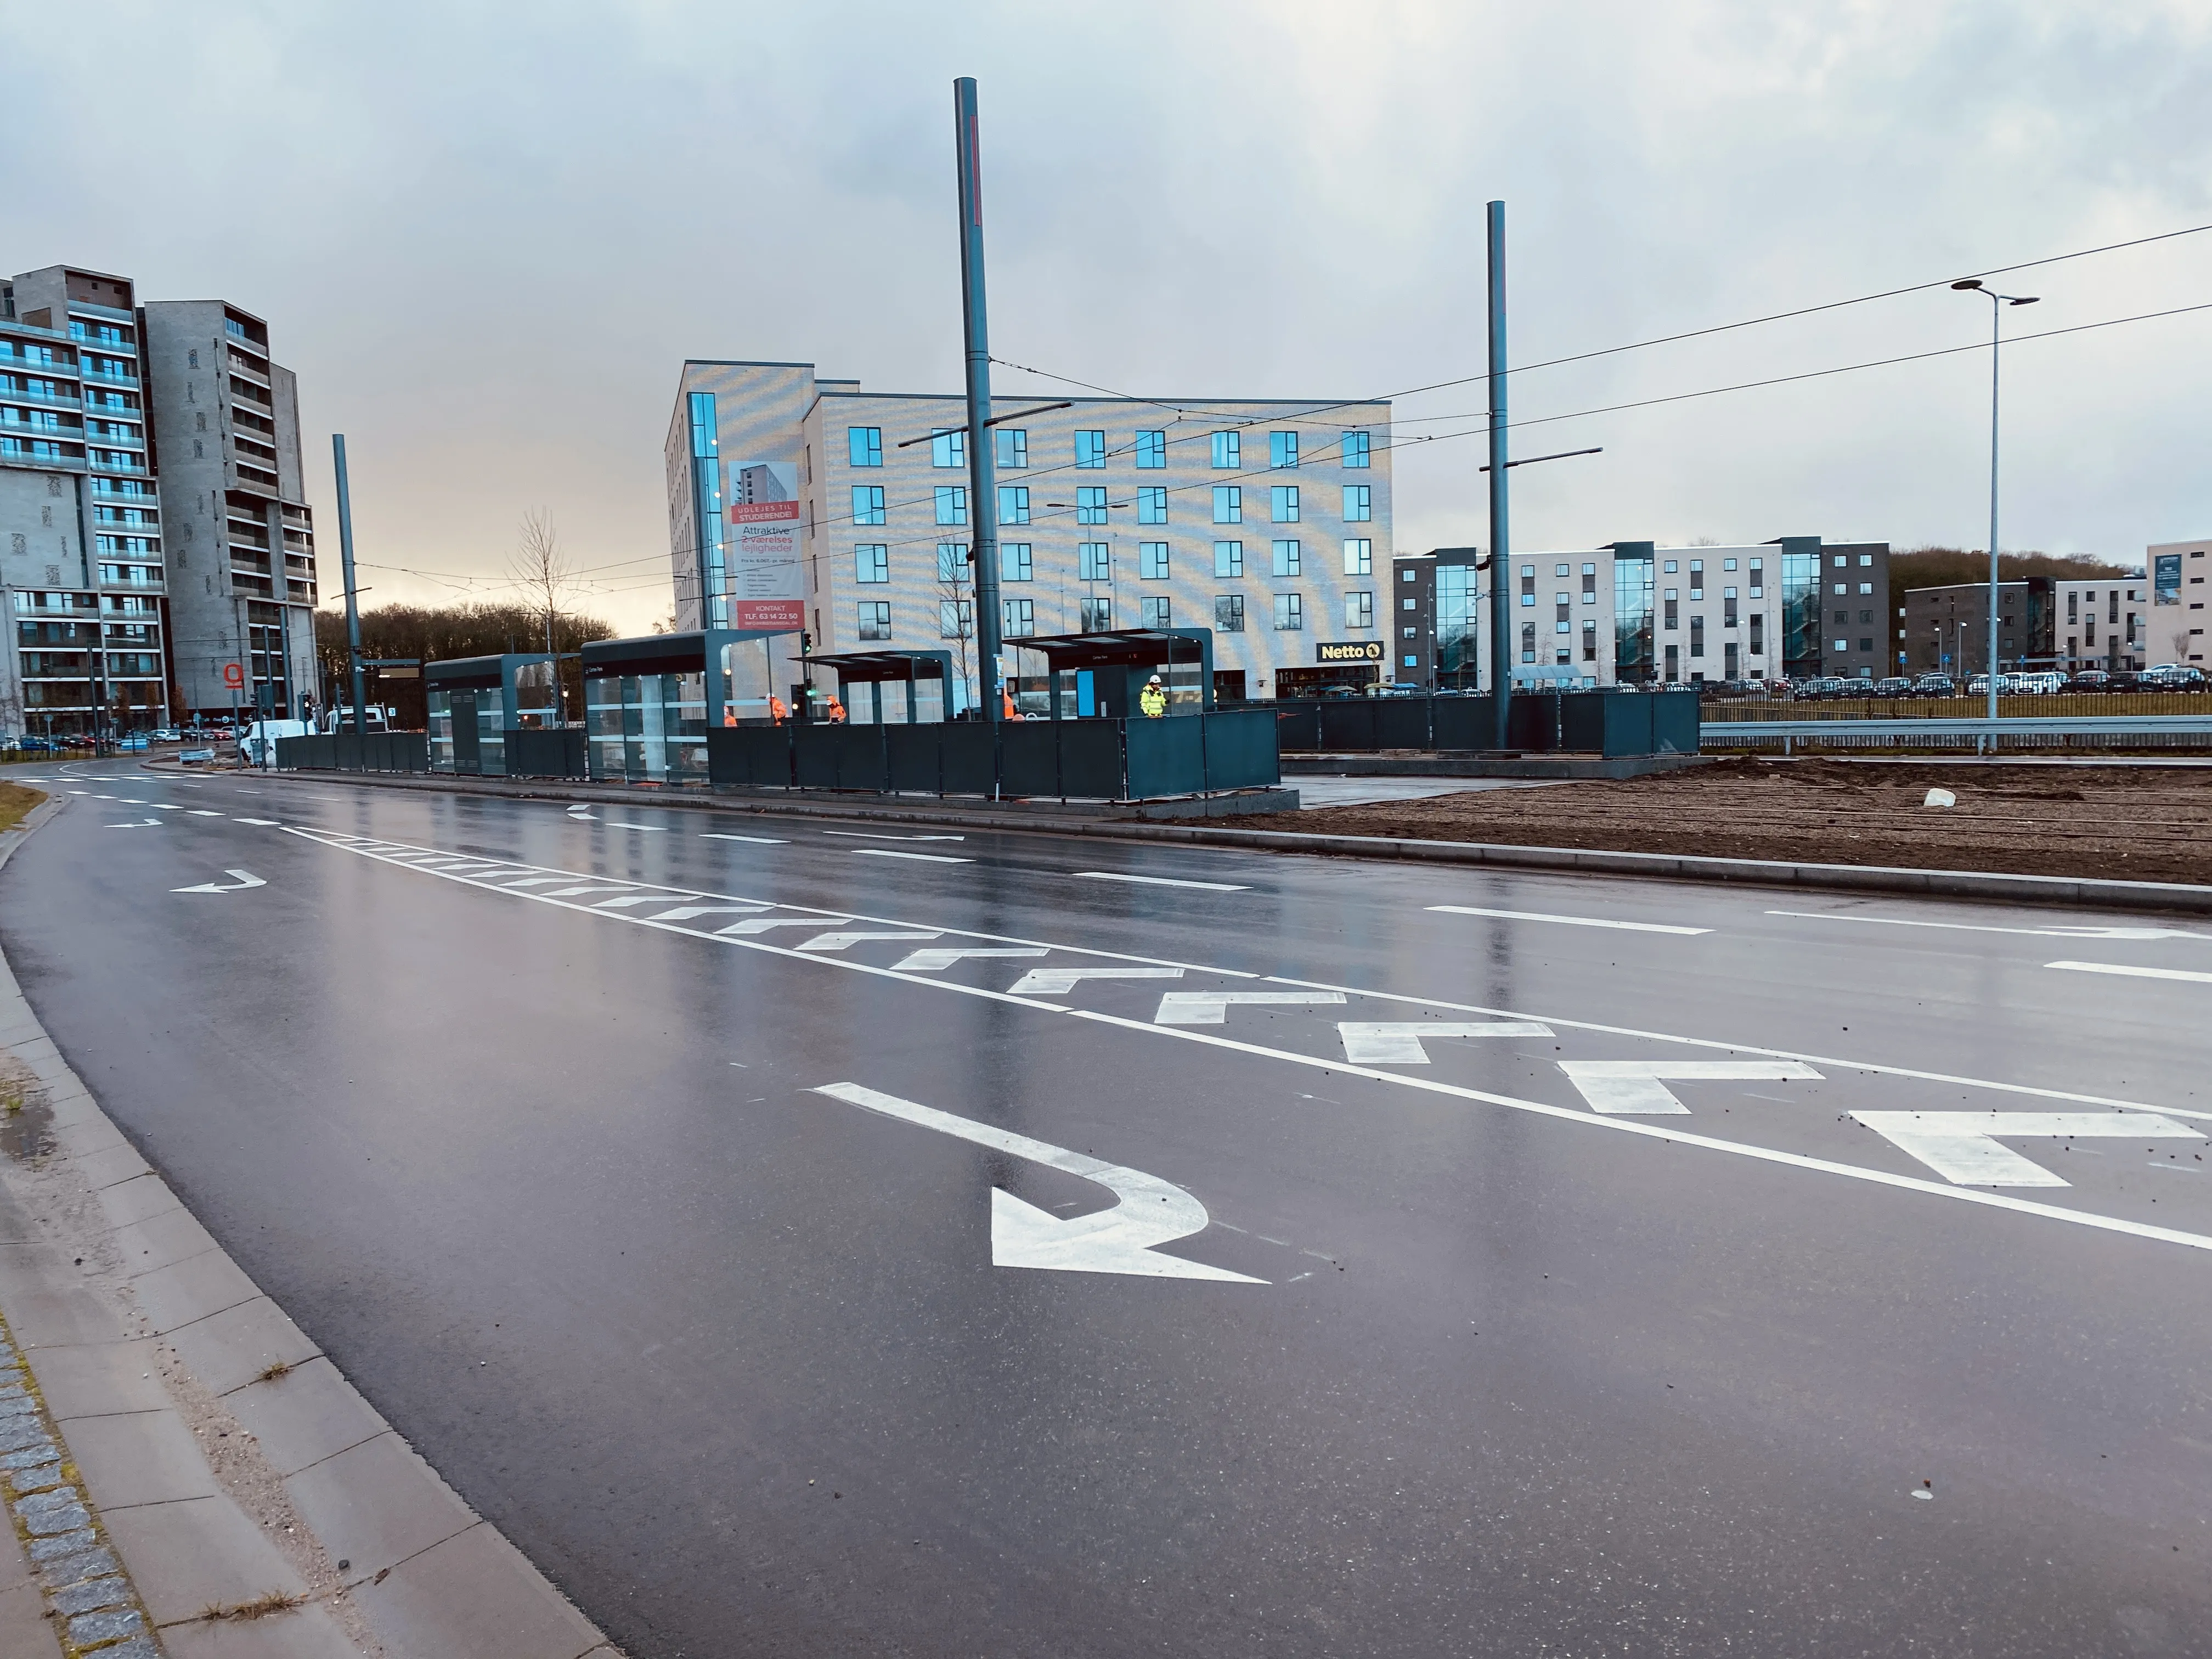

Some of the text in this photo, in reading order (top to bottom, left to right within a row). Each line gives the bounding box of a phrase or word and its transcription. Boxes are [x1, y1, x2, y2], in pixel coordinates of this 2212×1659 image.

[737, 505, 775, 514] UDLEJES
[743, 526, 789, 535] Attraktive
[741, 535, 793, 544] 2-værelses
[742, 543, 793, 554] lejligheder
[1322, 645, 1364, 659] Netto
